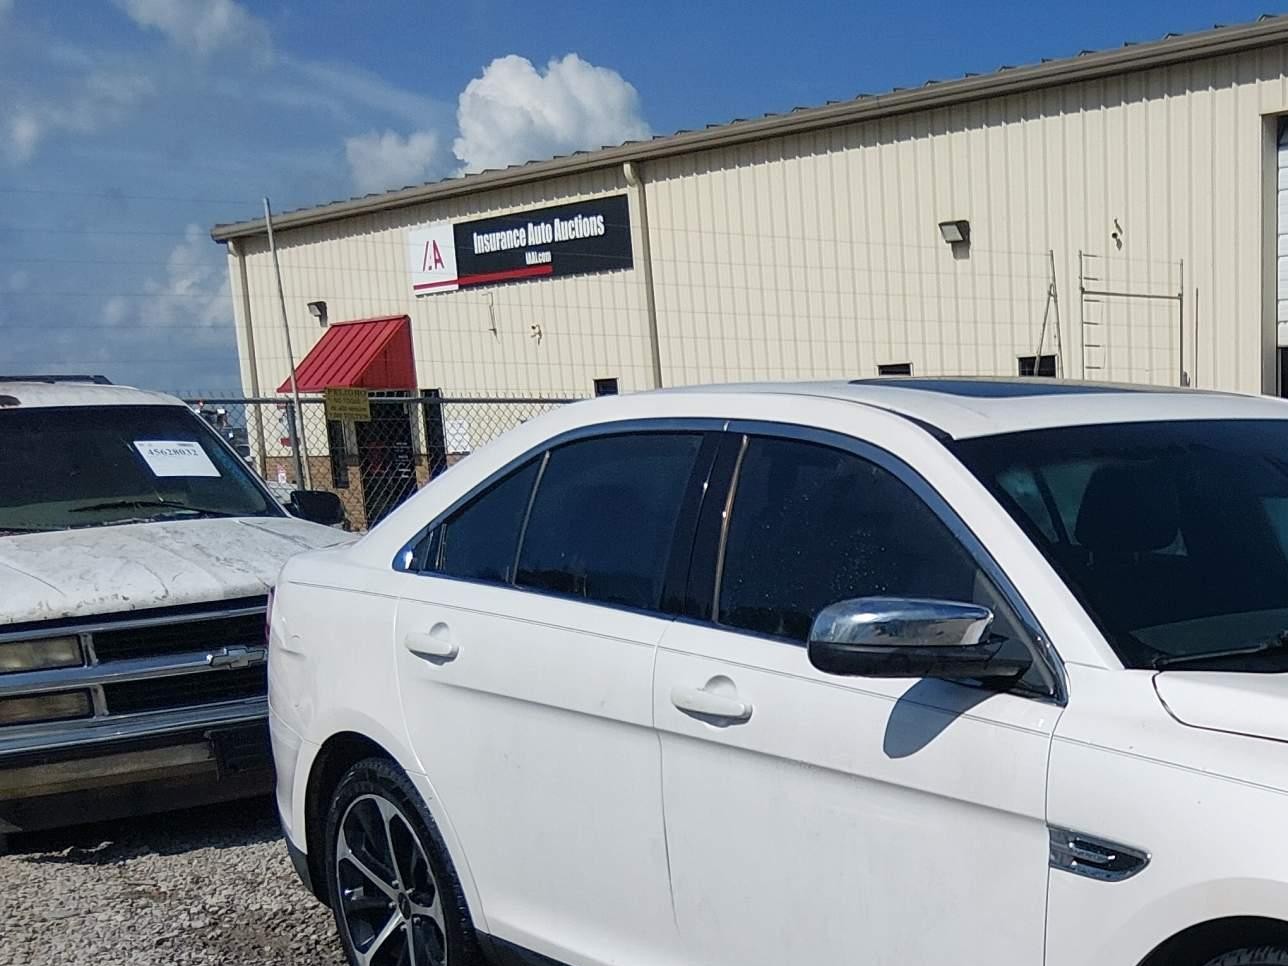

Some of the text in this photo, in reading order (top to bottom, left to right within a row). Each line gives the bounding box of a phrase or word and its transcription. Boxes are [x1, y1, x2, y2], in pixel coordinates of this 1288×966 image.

[473, 213, 606, 254] Insurance Auto Auctions
